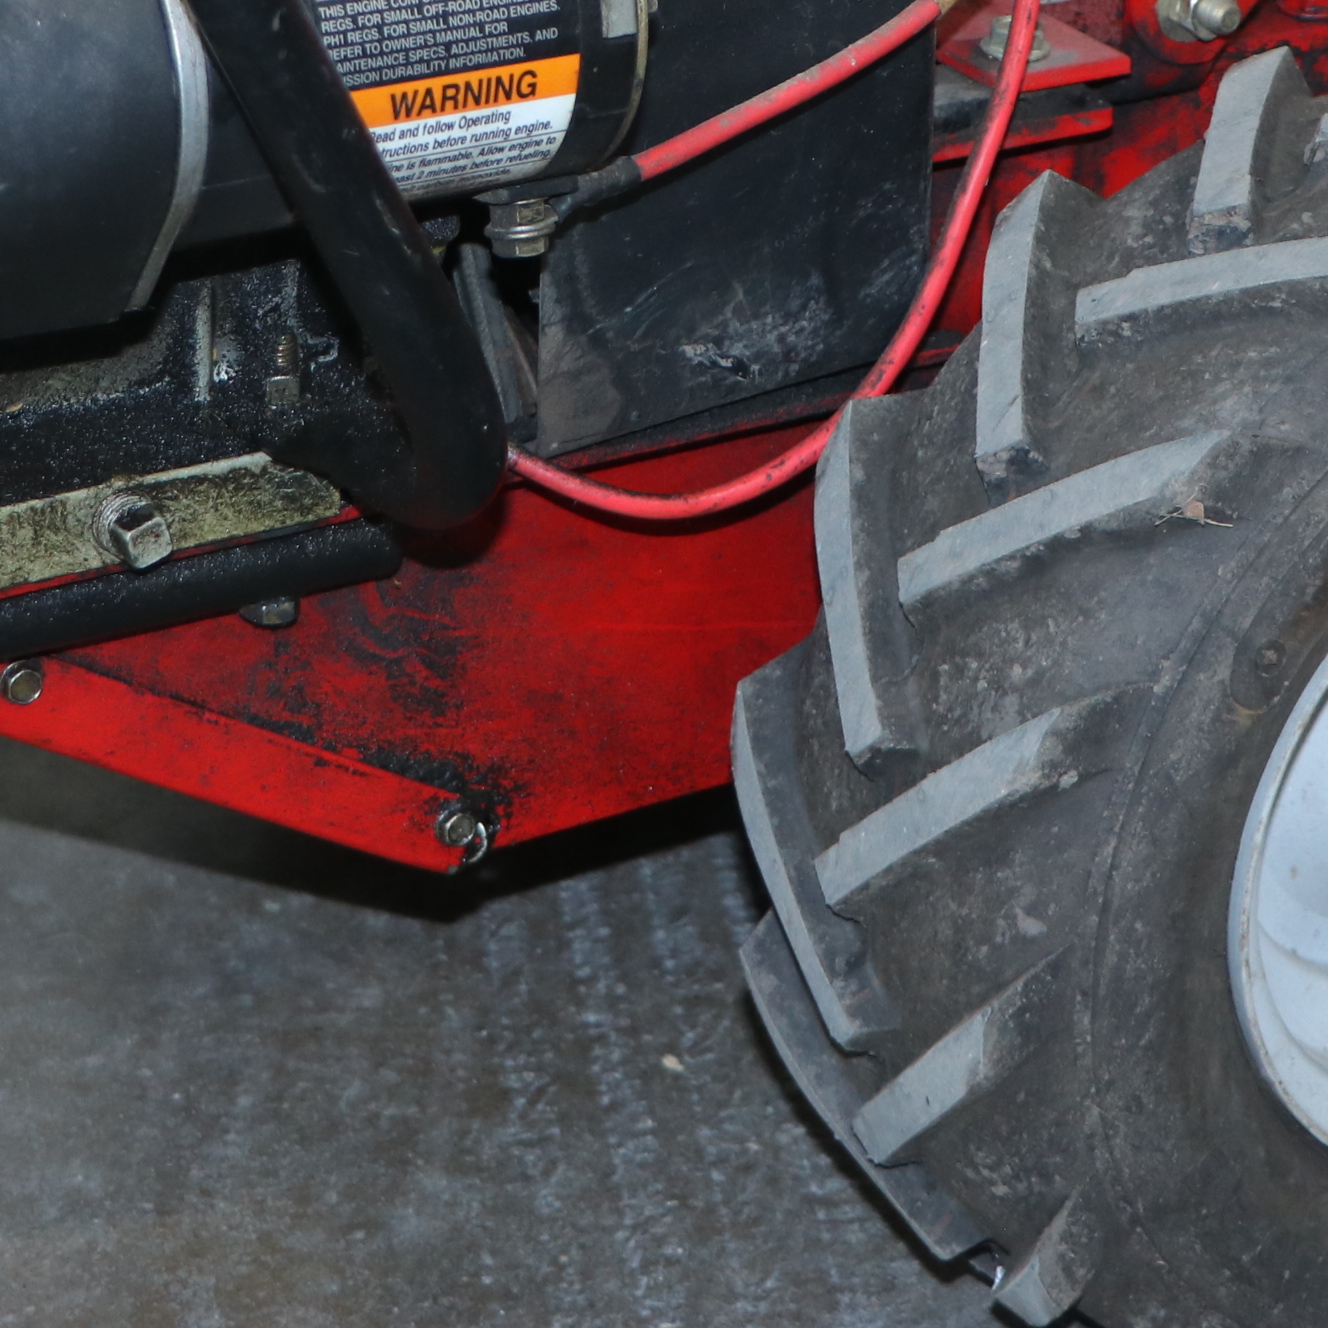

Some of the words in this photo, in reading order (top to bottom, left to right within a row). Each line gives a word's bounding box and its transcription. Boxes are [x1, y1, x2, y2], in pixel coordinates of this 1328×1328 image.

[318, 2, 344, 17] THIS
[320, 15, 355, 32] REGS.
[357, 11, 381, 26] FOR
[383, 5, 421, 23] SMALL
[323, 31, 343, 46] PH1
[347, 26, 380, 42] REGS.
[383, 22, 407, 37] FOR
[408, 16, 446, 33] SMALL
[448, 7, 508, 27] NON-ROAD
[510, 0, 559, 18] ENGINES.
[364, 40, 380, 54] TO
[382, 32, 434, 51] OWNER'S
[435, 25, 482, 43] MANUAL
[484, 21, 508, 36] FOR
[408, 44, 447, 61] SPECS,
[450, 31, 532, 55] ADJUSTMENTS,
[534, 26, 558, 42] AND
[382, 59, 446, 80] DURABILITY
[449, 46, 525, 70] INFORMATION.
[391, 70, 538, 120] WARNING
[398, 123, 419, 139] and
[422, 117, 455, 135] follow
[458, 108, 510, 132] Operating
[432, 132, 466, 149] before
[469, 124, 511, 146] running
[514, 117, 551, 139] engine.
